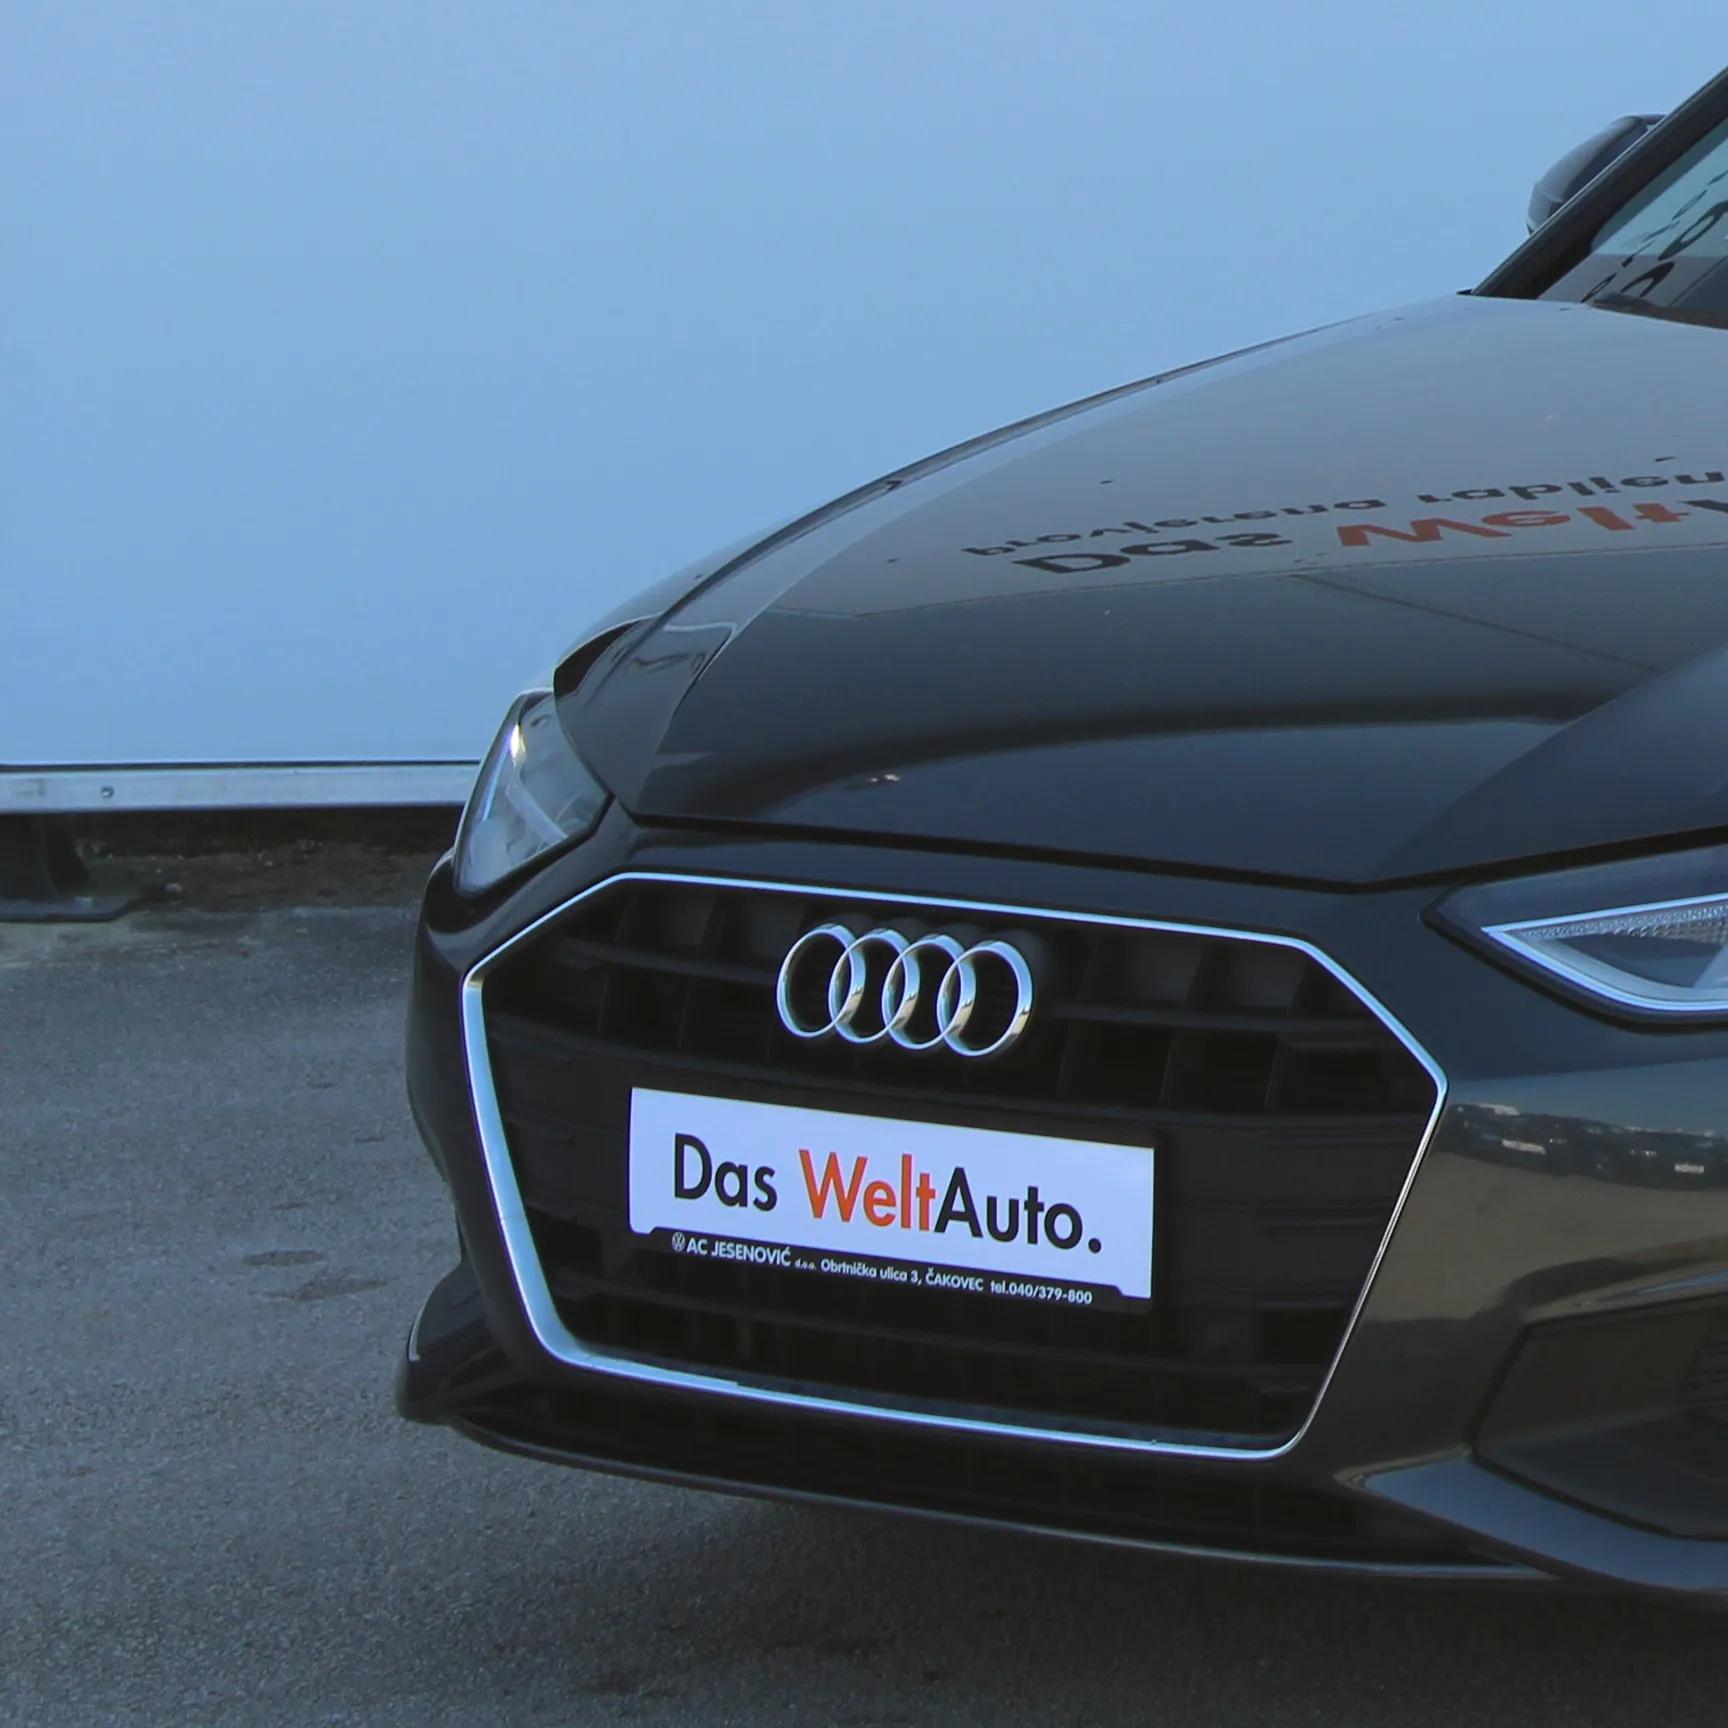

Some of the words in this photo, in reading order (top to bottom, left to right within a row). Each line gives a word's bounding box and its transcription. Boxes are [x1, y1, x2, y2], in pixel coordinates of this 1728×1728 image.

[673, 1132, 778, 1212] Das
[799, 1148, 1103, 1255] WeltAuto.
[686, 1237, 708, 1256] AC
[711, 1240, 792, 1268] JESENOVIĆ
[820, 1258, 877, 1279] Obrtnička
[880, 1267, 908, 1282] ulica
[910, 1270, 922, 1287] 3,
[925, 1268, 984, 1293] ČAKOVEC
[990, 1280, 1093, 1306] tel.040/379-800
